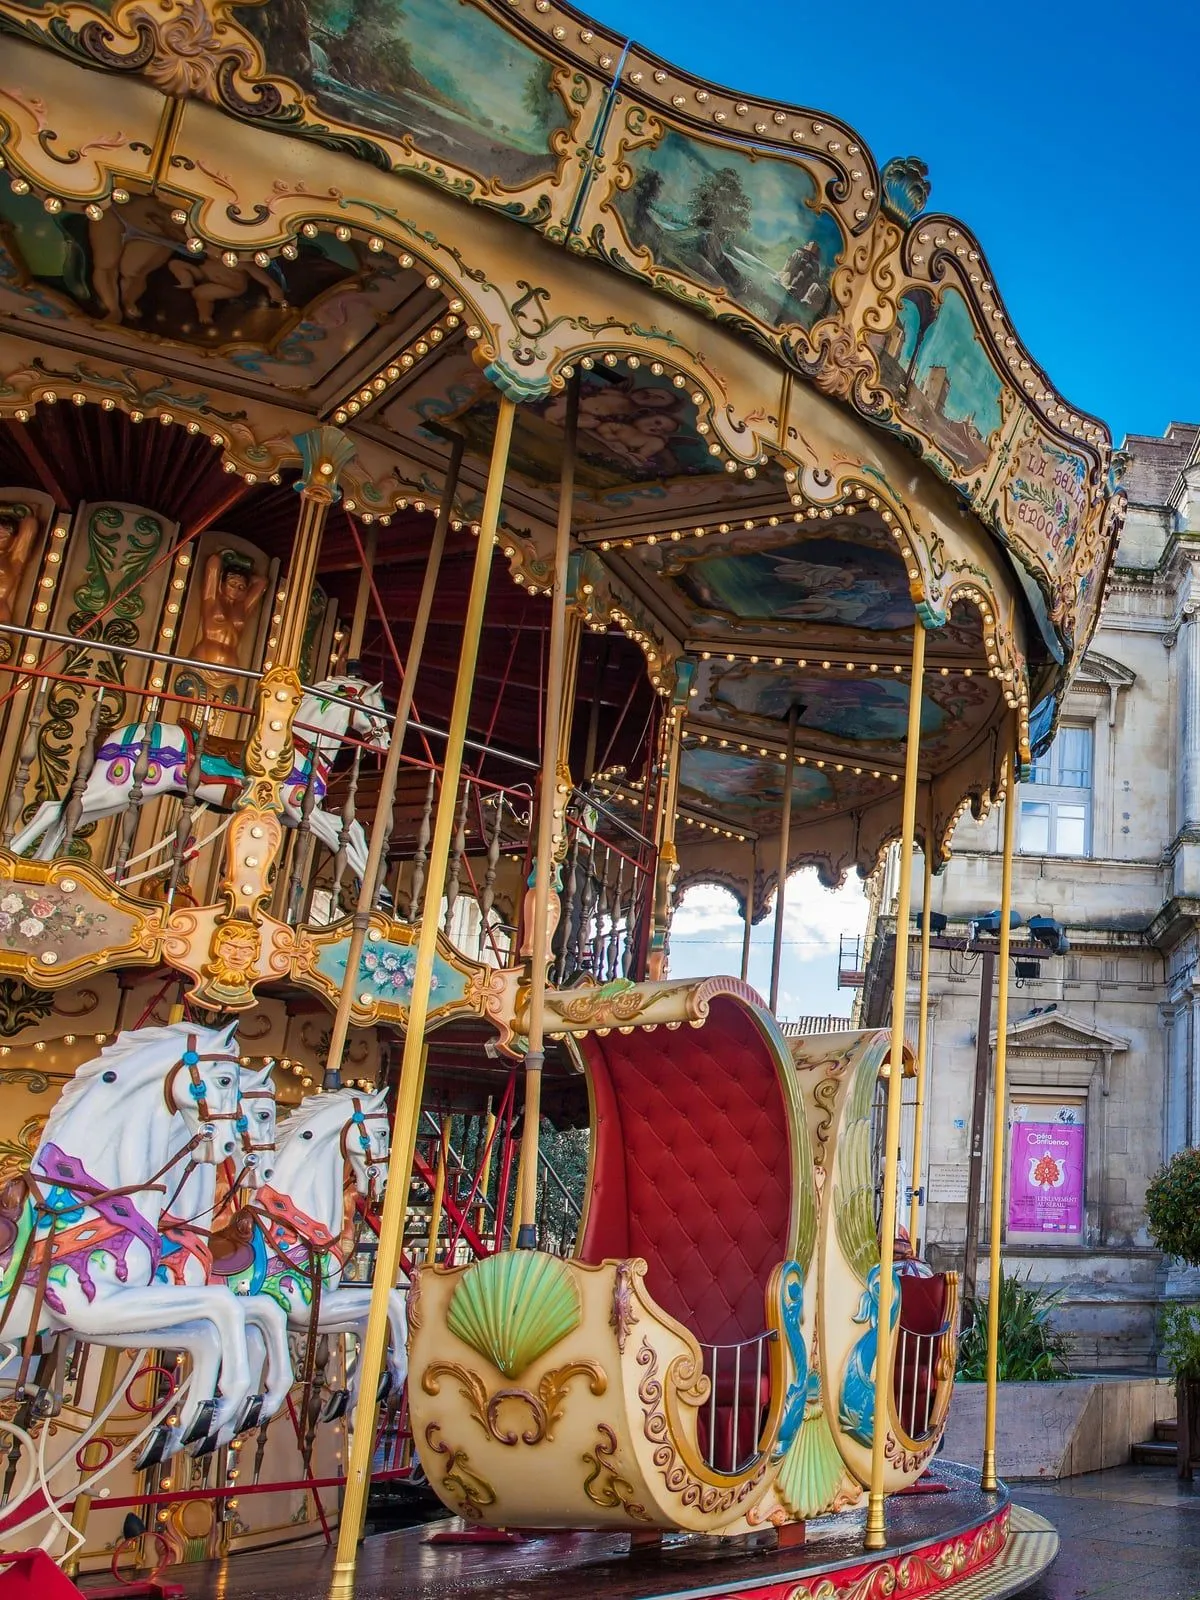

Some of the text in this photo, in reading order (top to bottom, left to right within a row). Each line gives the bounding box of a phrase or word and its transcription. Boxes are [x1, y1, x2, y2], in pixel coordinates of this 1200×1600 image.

[1027, 453, 1086, 514] LA BELLE
[1027, 1137, 1070, 1146] Confluence
